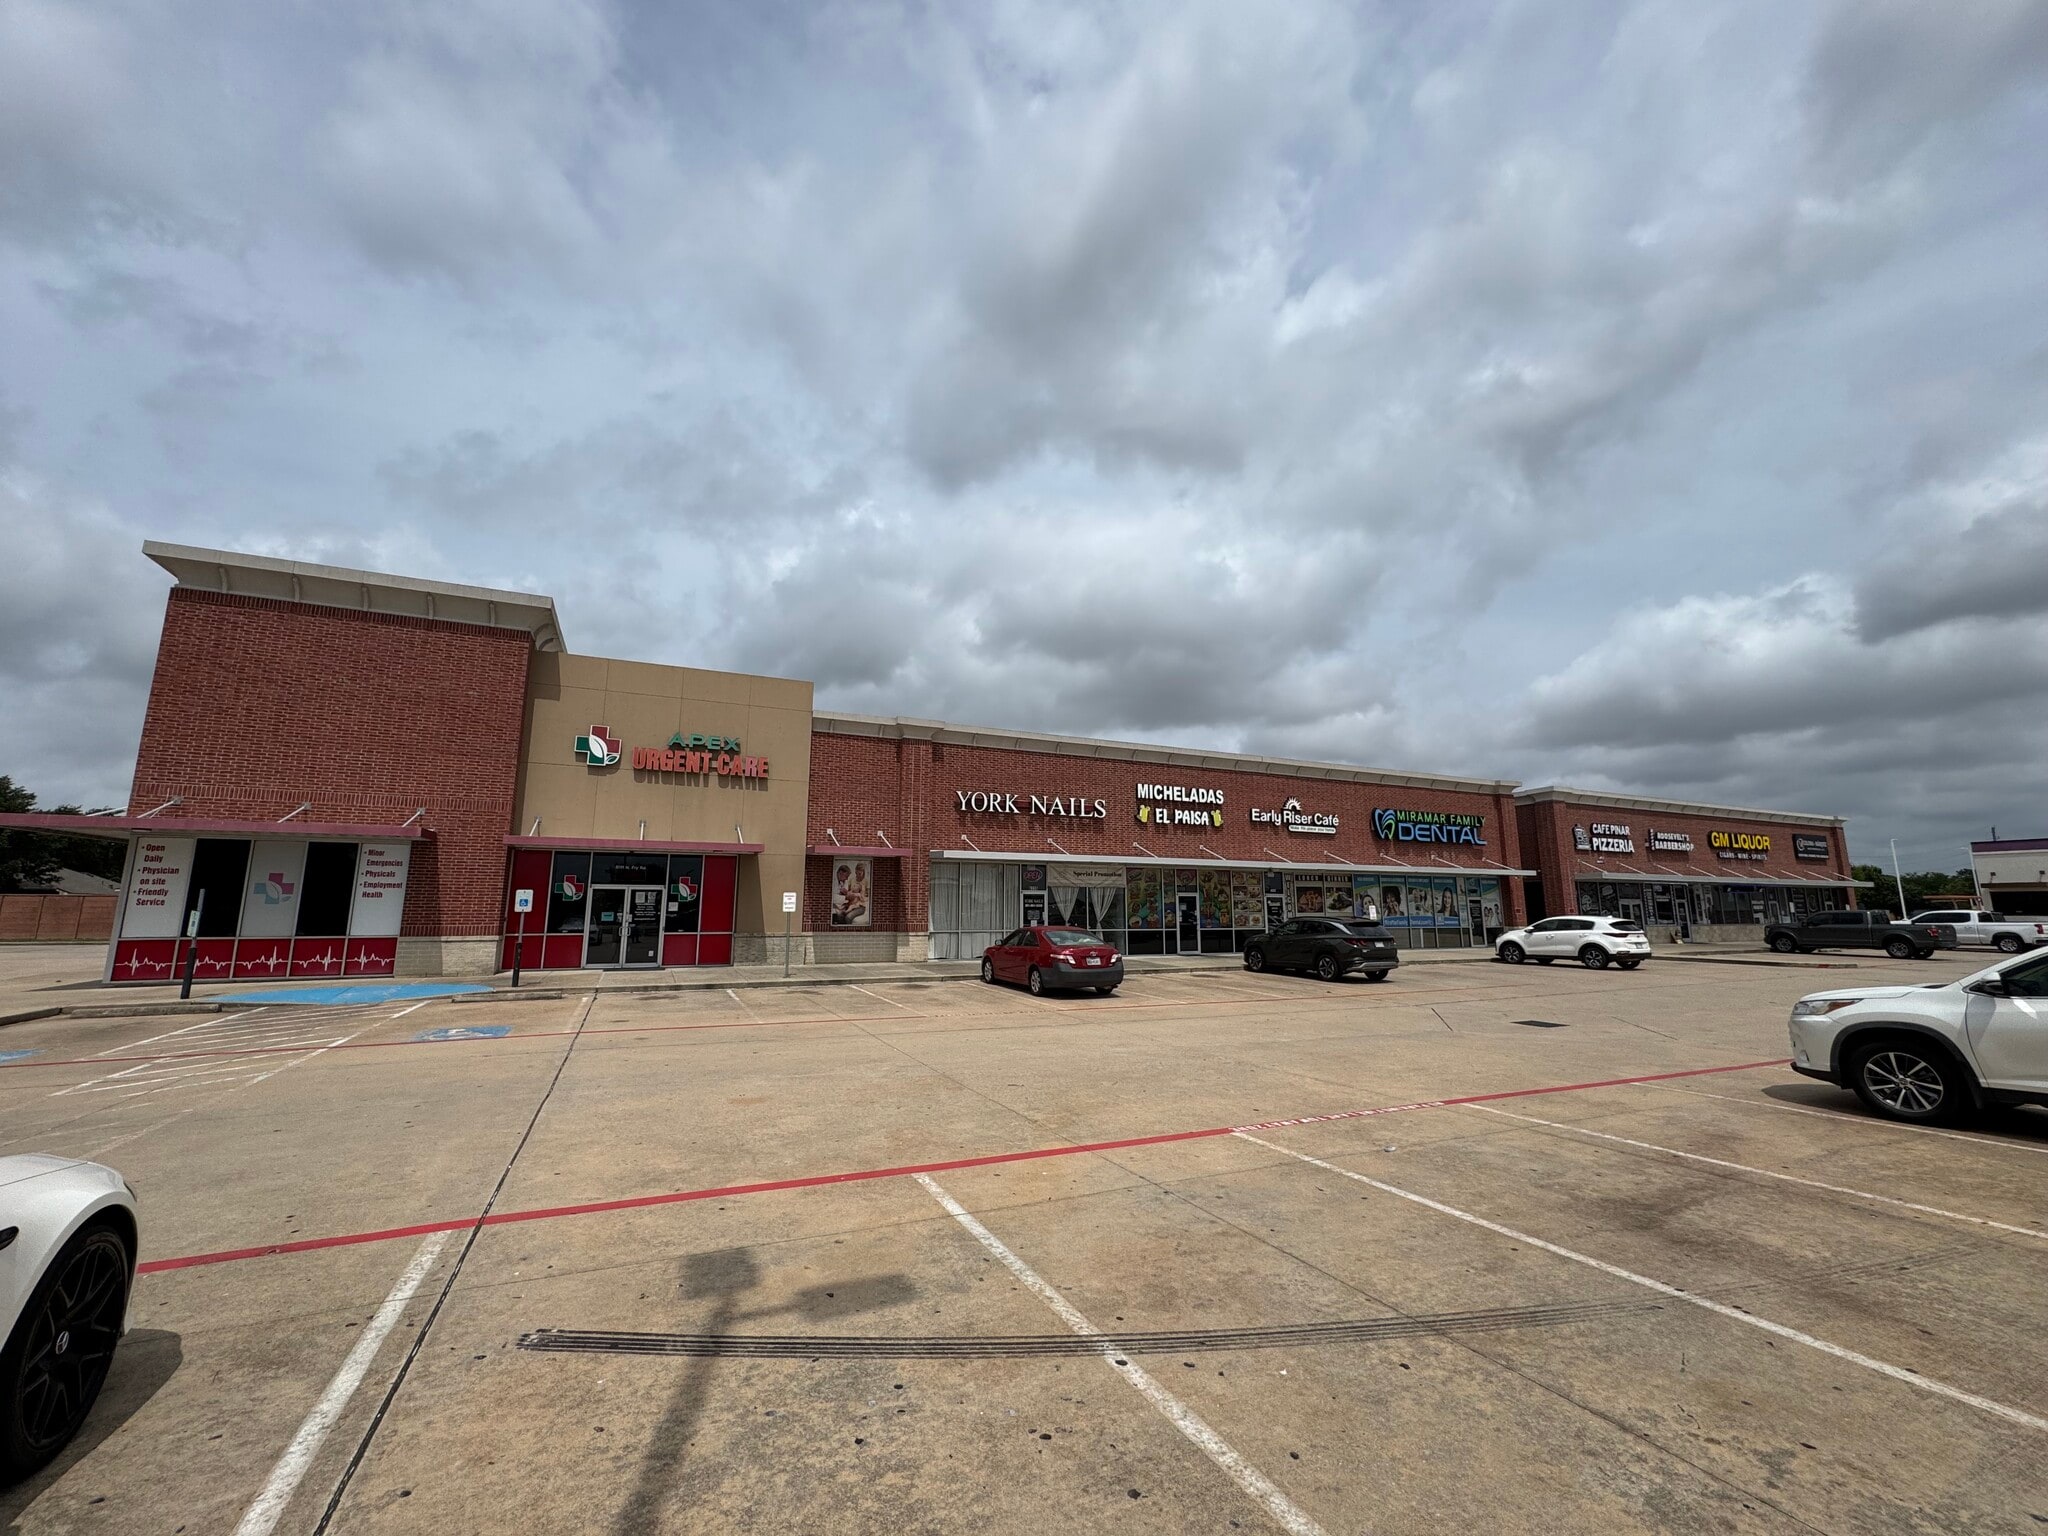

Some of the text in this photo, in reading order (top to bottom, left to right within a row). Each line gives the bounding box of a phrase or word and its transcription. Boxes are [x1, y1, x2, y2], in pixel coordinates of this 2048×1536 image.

[667, 731, 741, 751] APEX
[632, 746, 769, 778] URGENT CARE
[1137, 783, 1224, 805] MICHELADAS
[956, 790, 1107, 818] YORK NAILS
[1155, 807, 1209, 826] EL PAISA
[1251, 808, 1340, 826] Early Riser Café
[1397, 810, 1487, 827] MIRAMAR FAMILY
[1398, 822, 1488, 845] DENTAL
[1592, 823, 1610, 834] CAFE
[1592, 837, 1635, 853] PIZZERIA
[1655, 840, 1695, 852] BARBERSHOP
[1711, 831, 1771, 851] GM LIQUOR
[145, 843, 166, 852] Open
[144, 854, 164, 863] Daily
[366, 859, 404, 867] Emergencies
[141, 866, 180, 875] Physician
[365, 870, 396, 878] Physicals
[363, 881, 403, 889] Employment
[137, 888, 169, 897] Friendly
[362, 890, 383, 898] Health
[136, 898, 166, 906] Service
